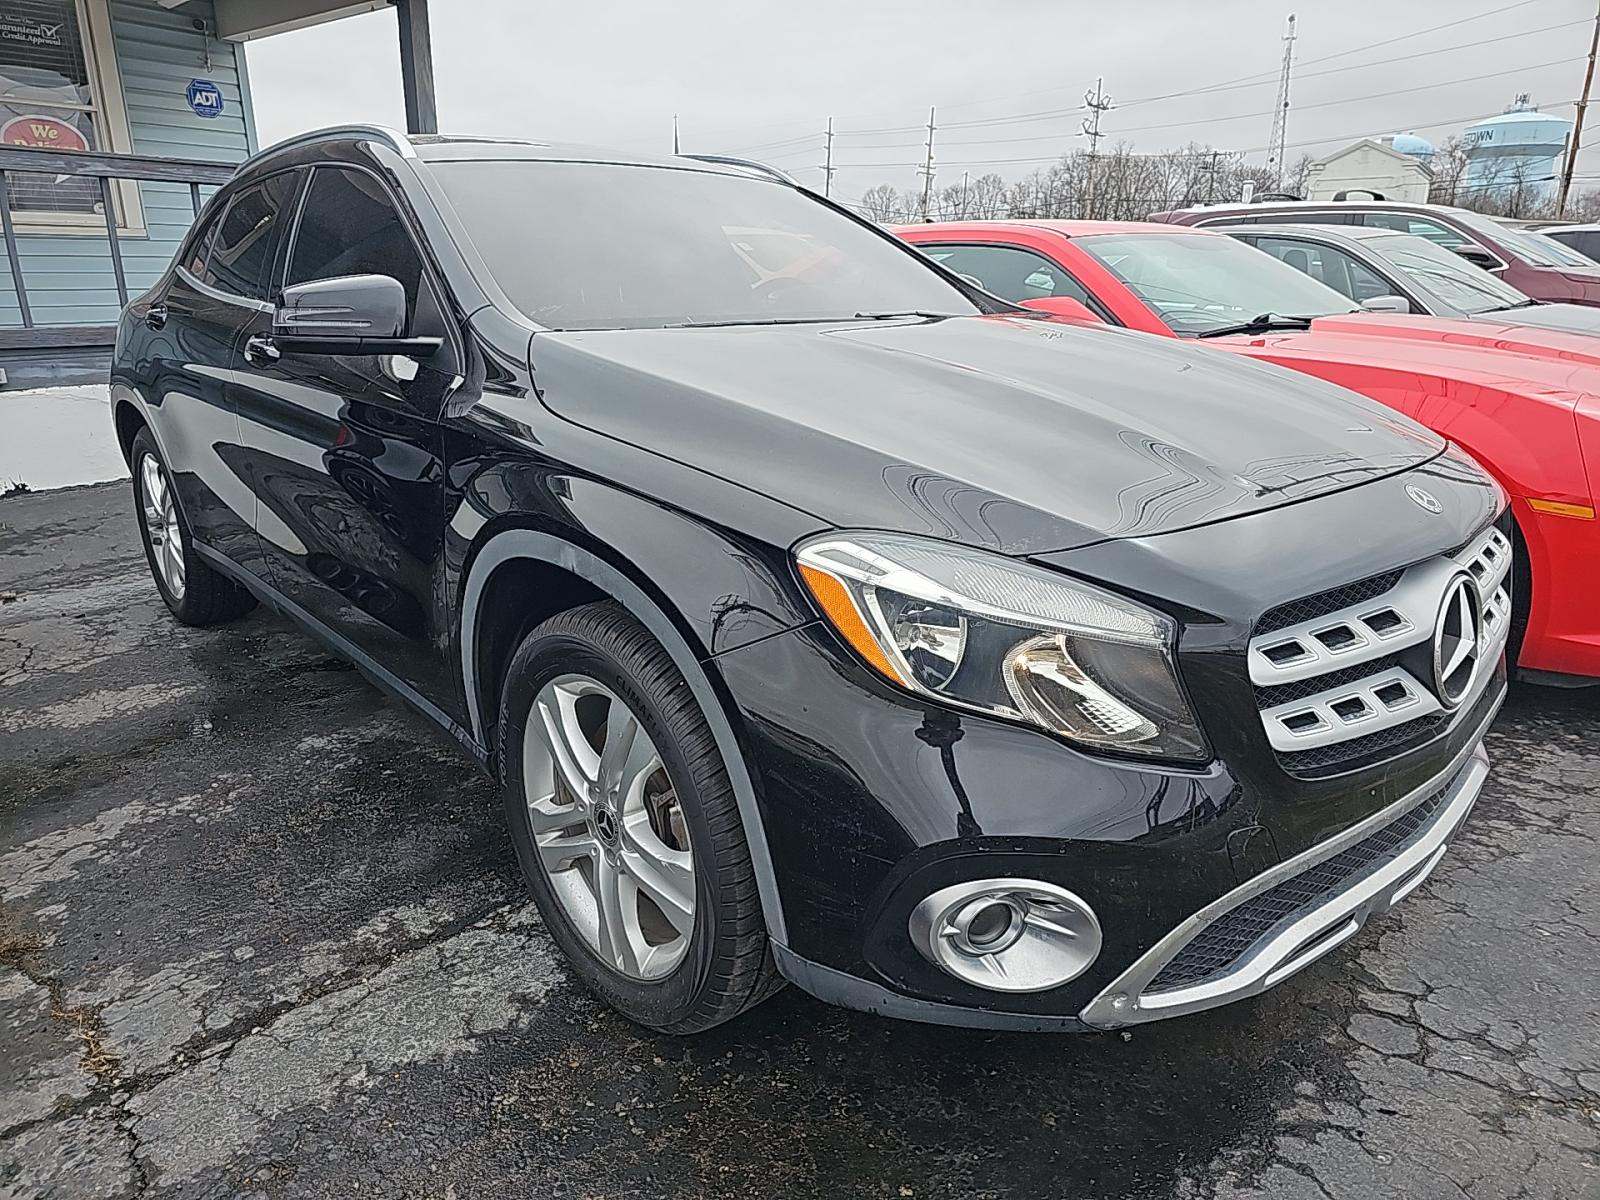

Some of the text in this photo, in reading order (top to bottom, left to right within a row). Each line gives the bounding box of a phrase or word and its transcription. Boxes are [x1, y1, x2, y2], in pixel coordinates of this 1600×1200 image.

[27, 34, 61, 46] Approval
[194, 91, 218, 107] ADT
[30, 124, 59, 139] We
